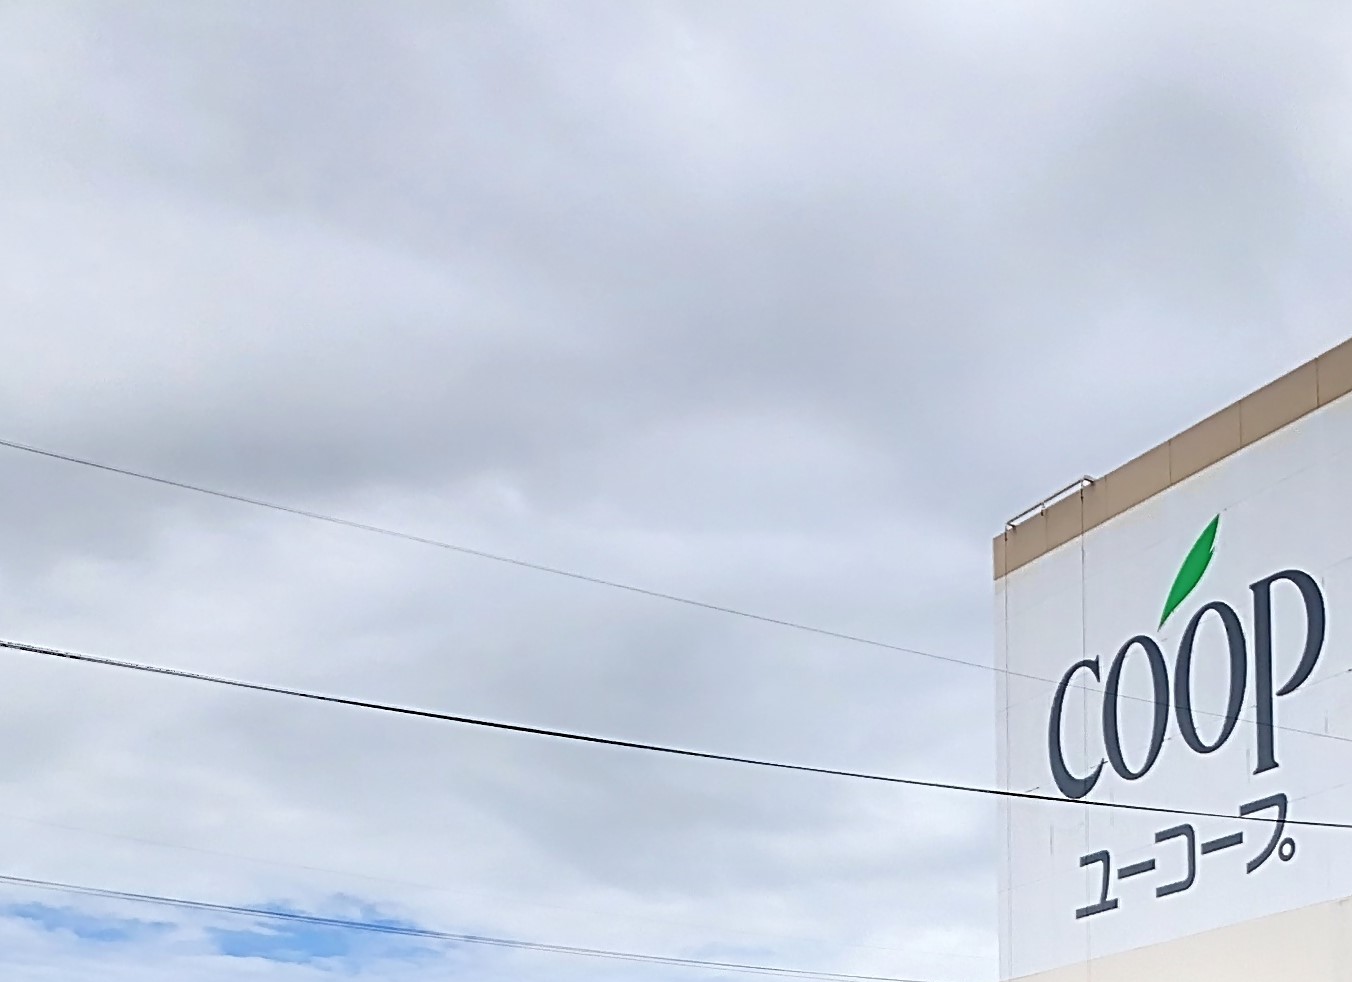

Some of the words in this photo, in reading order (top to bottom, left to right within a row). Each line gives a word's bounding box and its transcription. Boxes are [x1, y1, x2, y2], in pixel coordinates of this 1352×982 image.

[1048, 569, 1326, 800] COOP
[1075, 792, 1296, 920] ユーコープ
